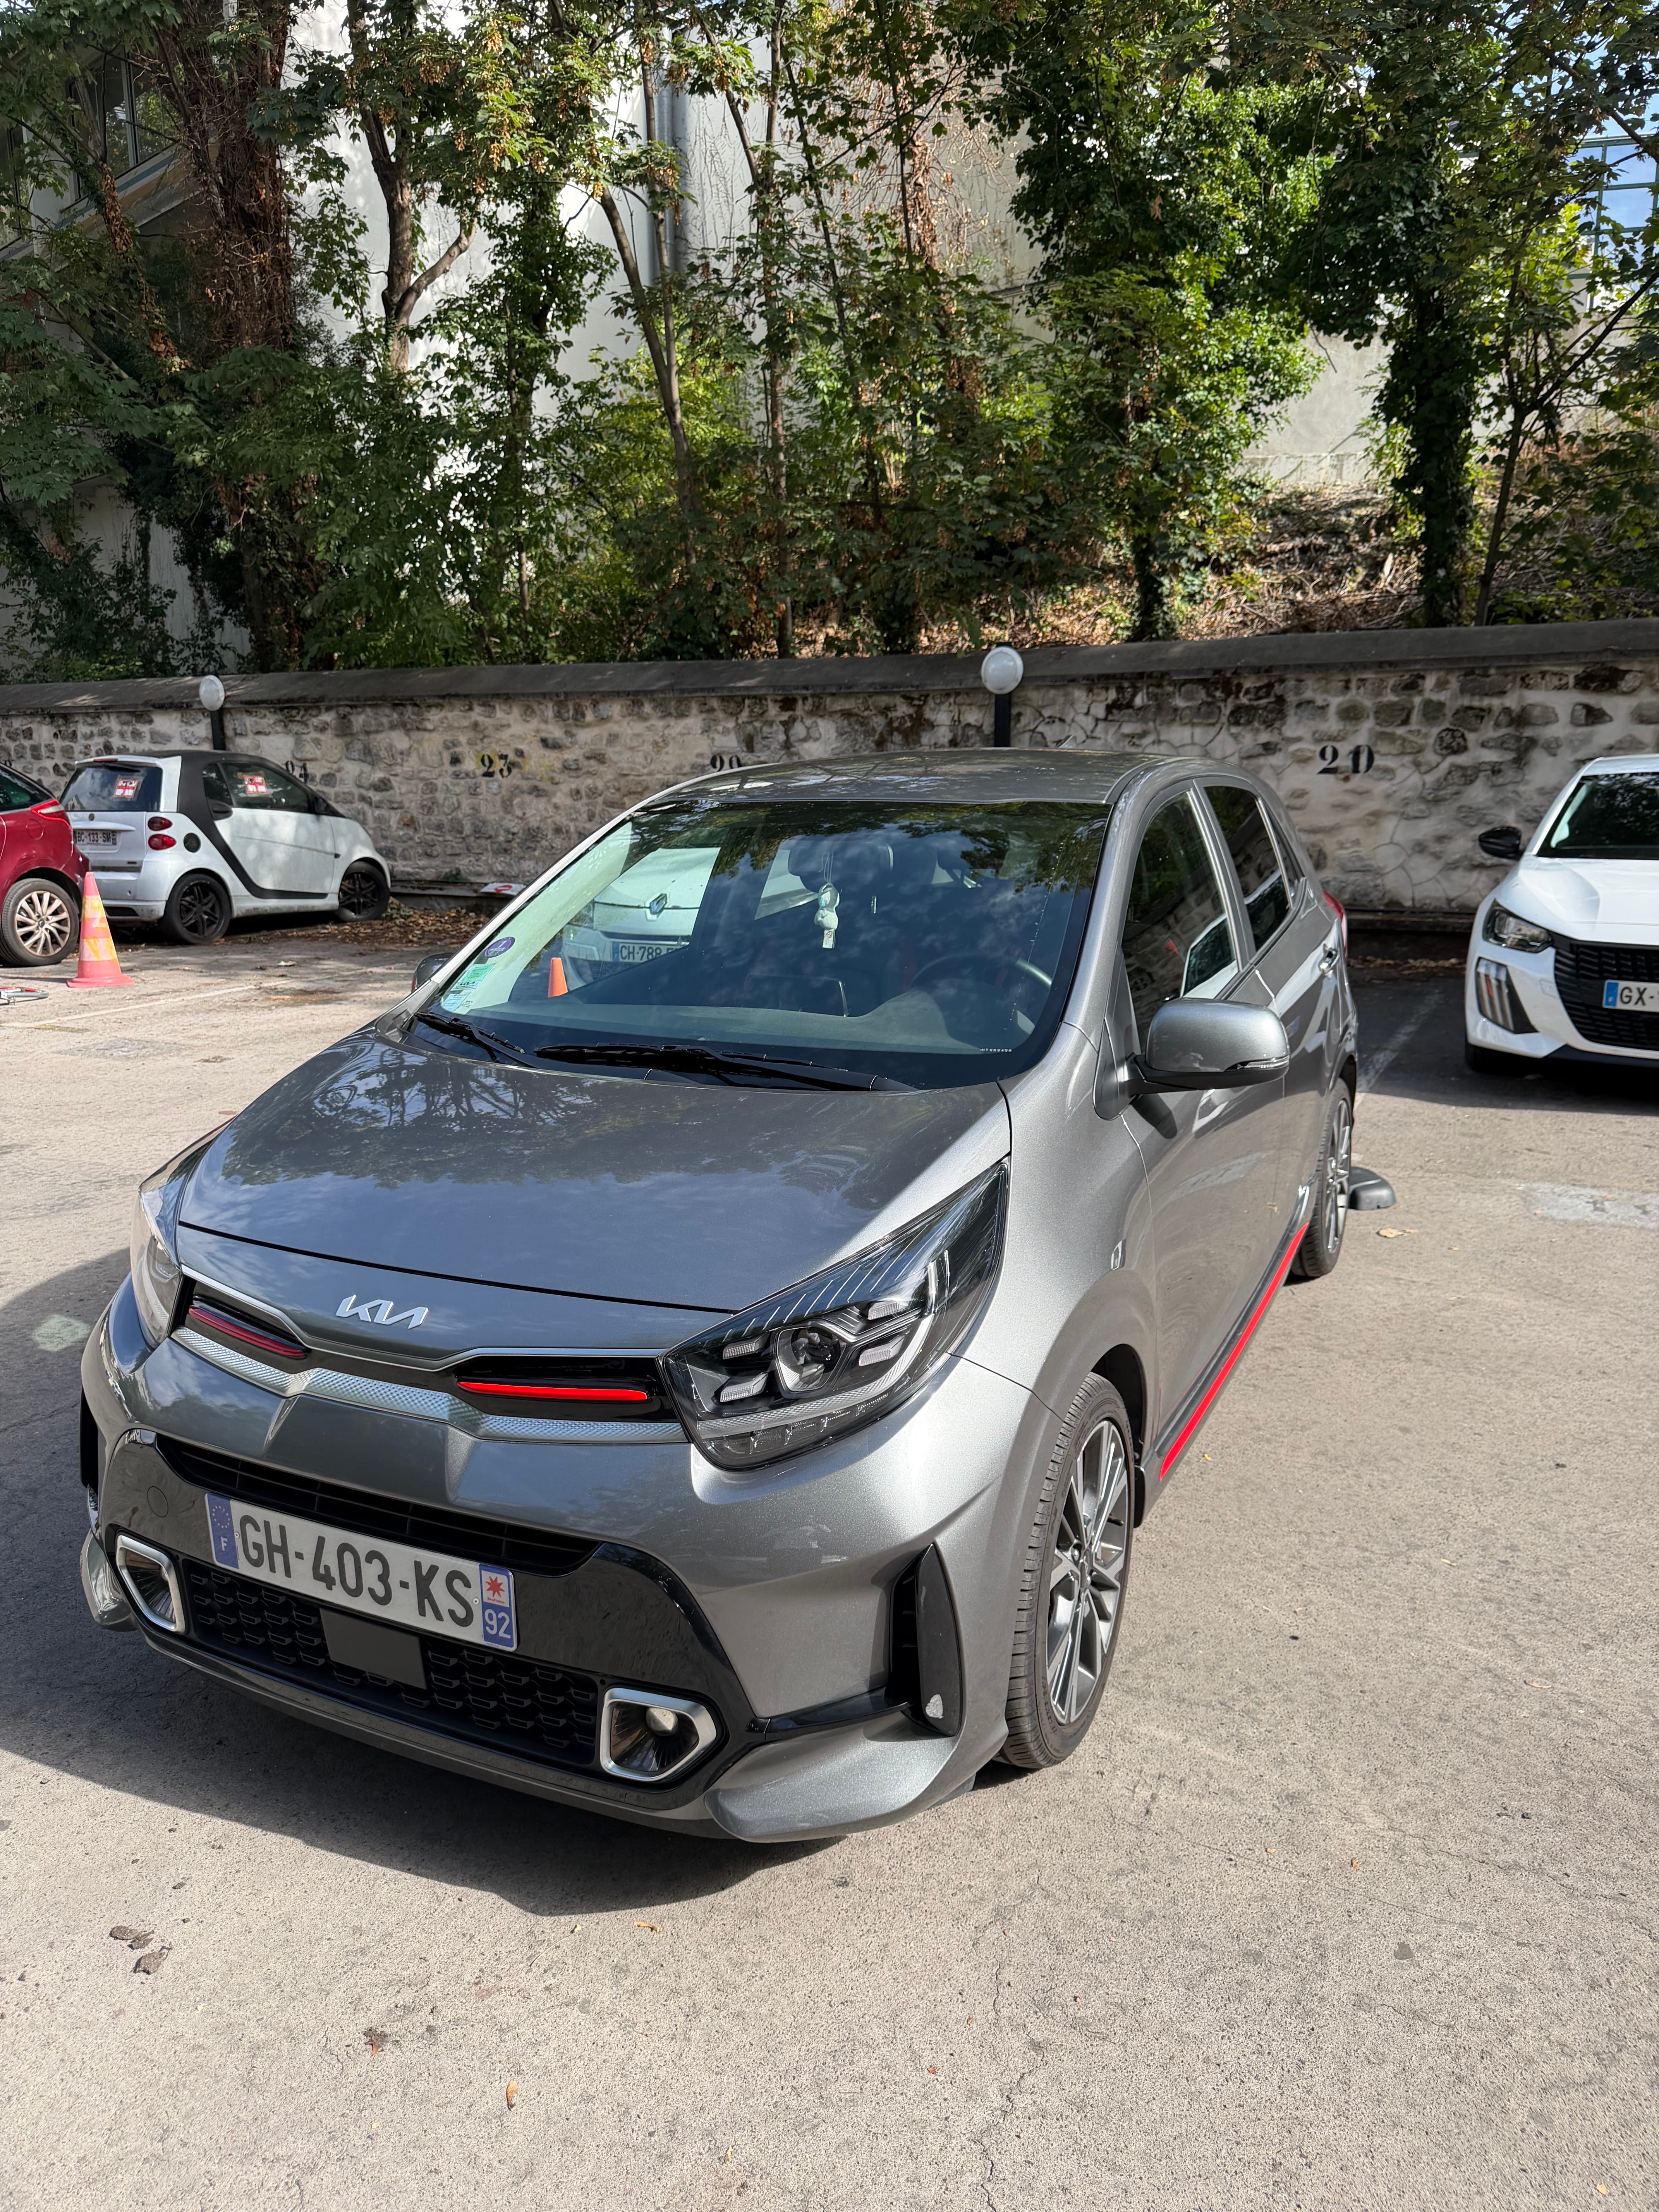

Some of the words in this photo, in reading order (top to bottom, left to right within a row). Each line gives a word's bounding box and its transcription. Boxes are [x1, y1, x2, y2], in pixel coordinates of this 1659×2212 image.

[481, 754, 512, 778] 23
[1620, 986, 1659, 1006] GX-
[336, 1295, 429, 1330] KIA
[221, 1536, 228, 1551] F
[239, 1515, 474, 1627] GH-403-KS
[485, 1609, 511, 1639] 92
